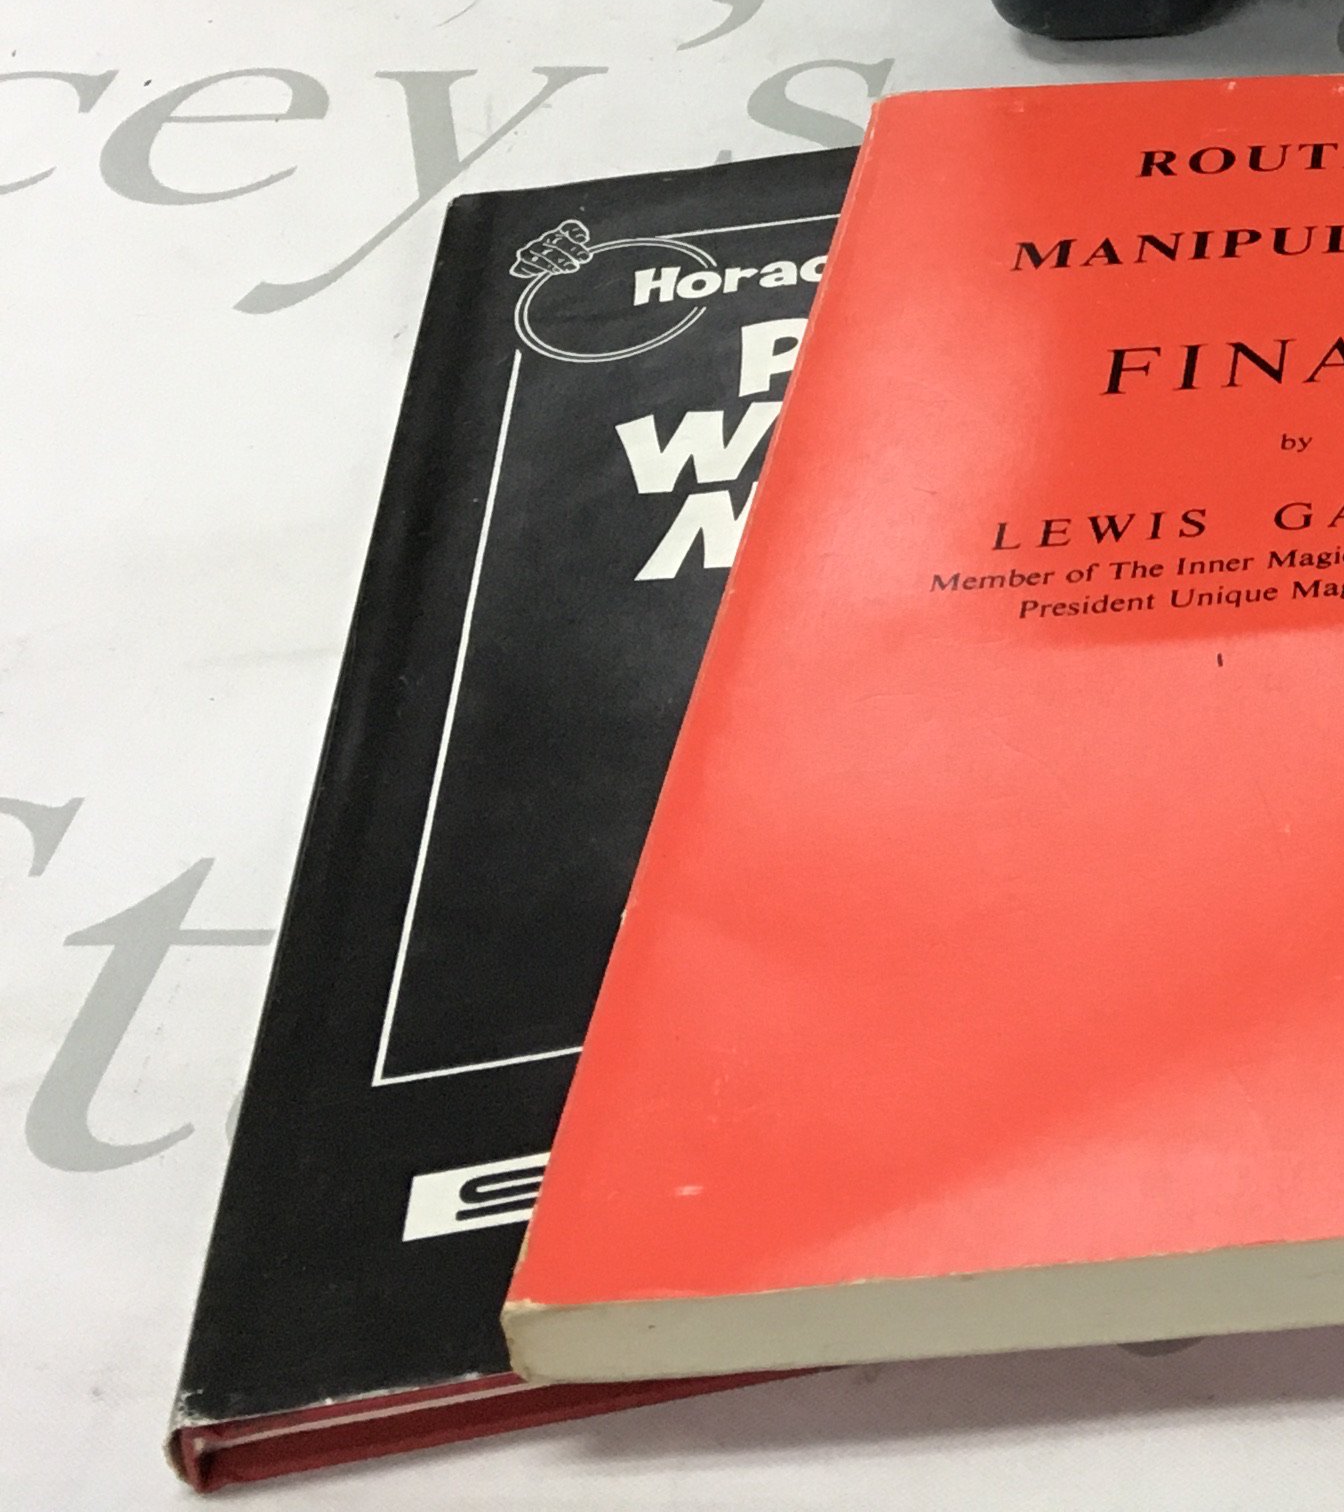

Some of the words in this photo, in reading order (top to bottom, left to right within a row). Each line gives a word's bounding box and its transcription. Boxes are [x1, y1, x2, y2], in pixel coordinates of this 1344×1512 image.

[1281, 431, 1313, 455] by
[992, 508, 1207, 551] LEWIS
[930, 569, 1055, 593] Member
[1065, 562, 1100, 584] of
[1109, 560, 1164, 580] The
[1176, 556, 1255, 576] Inner
[1019, 592, 1156, 619] President
[1170, 584, 1279, 608] Unique
